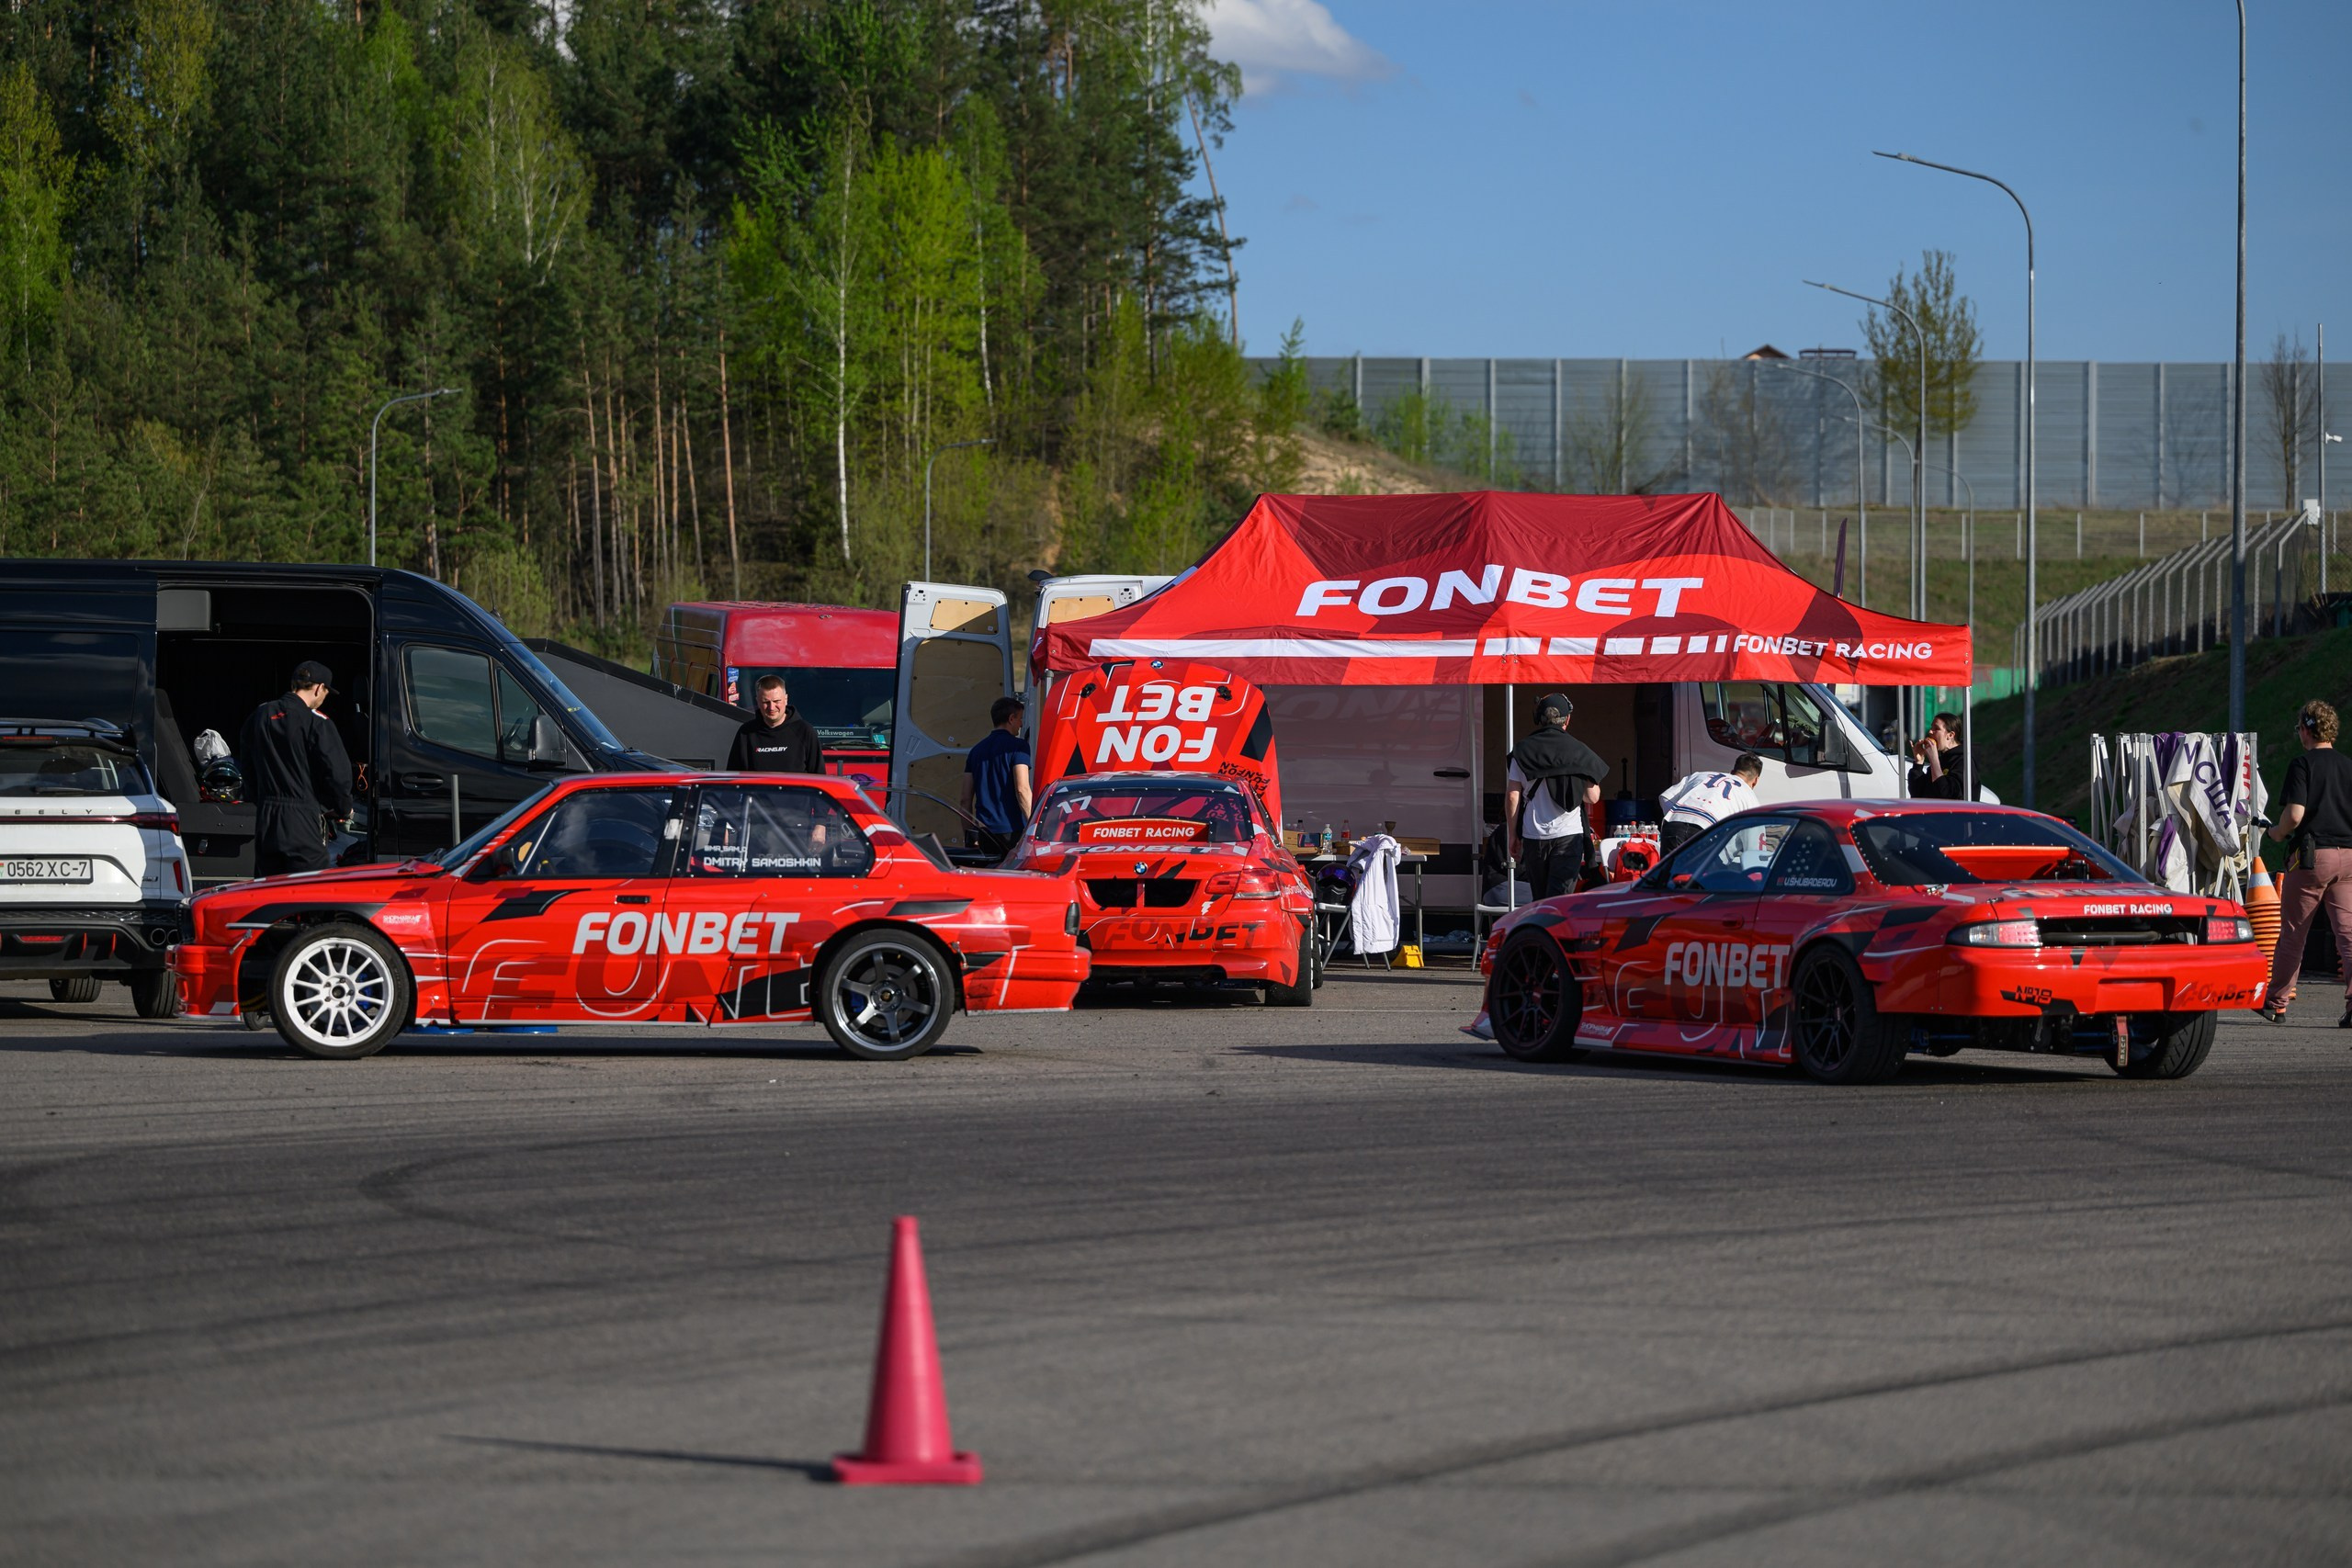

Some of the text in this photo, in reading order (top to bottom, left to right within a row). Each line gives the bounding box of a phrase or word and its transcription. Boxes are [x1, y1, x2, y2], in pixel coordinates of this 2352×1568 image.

[1295, 564, 1703, 617] FONBET
[1733, 635, 1933, 660] FONBET RACING
[1095, 684, 1217, 723] BET
[1095, 725, 1217, 763] FON
[1057, 795, 1092, 814] 17
[1093, 827, 1195, 838] FONBET RACING
[7, 862, 44, 877] 0562
[704, 857, 821, 867] DMITRY SAMOSHKIN
[2084, 903, 2173, 915] FONBET RACING
[572, 911, 801, 955] FONBET
[1664, 942, 1791, 988] FONBET
